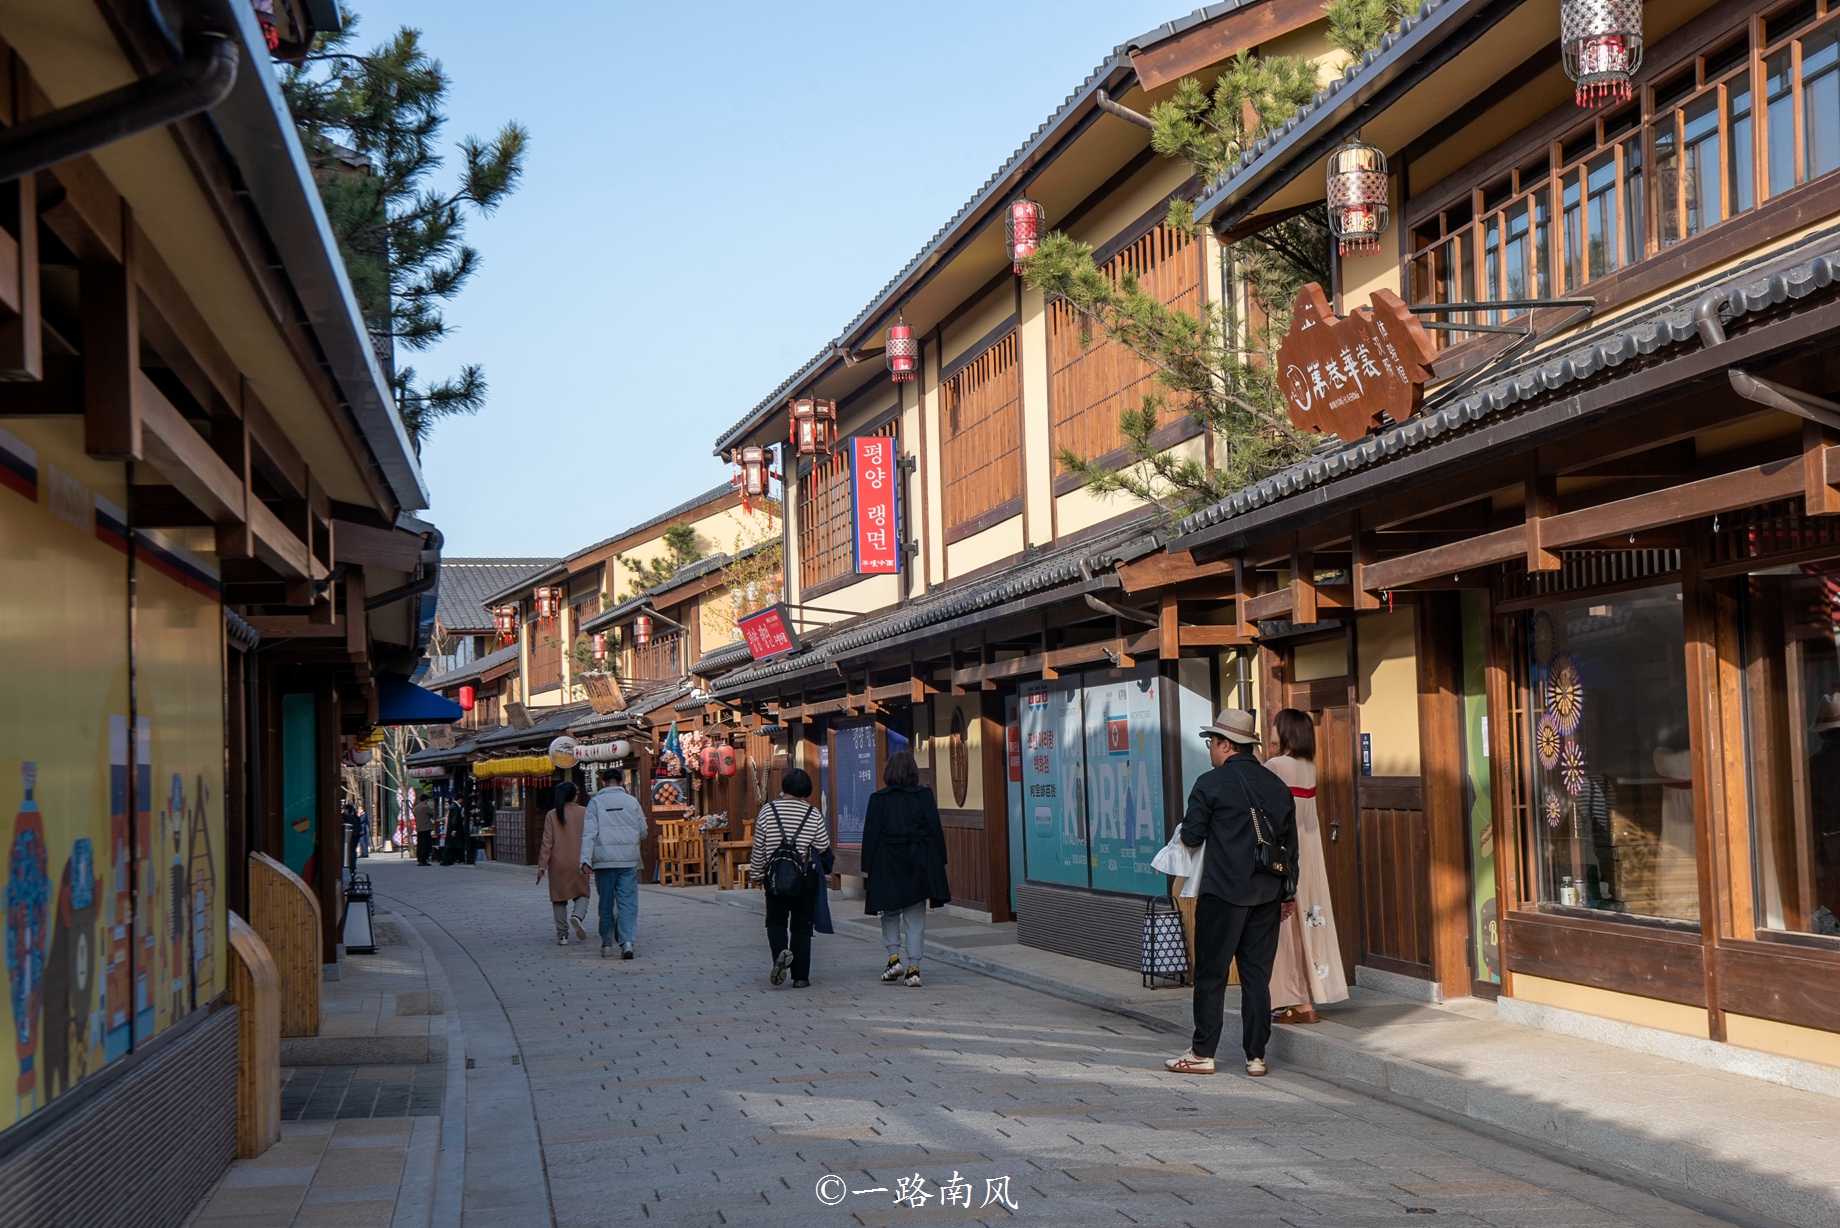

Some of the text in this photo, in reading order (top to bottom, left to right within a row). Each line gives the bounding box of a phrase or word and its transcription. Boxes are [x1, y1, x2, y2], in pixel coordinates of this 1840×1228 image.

[863, 442, 888, 551] 평양 랭면
[1108, 858, 1118, 871] ASIA
